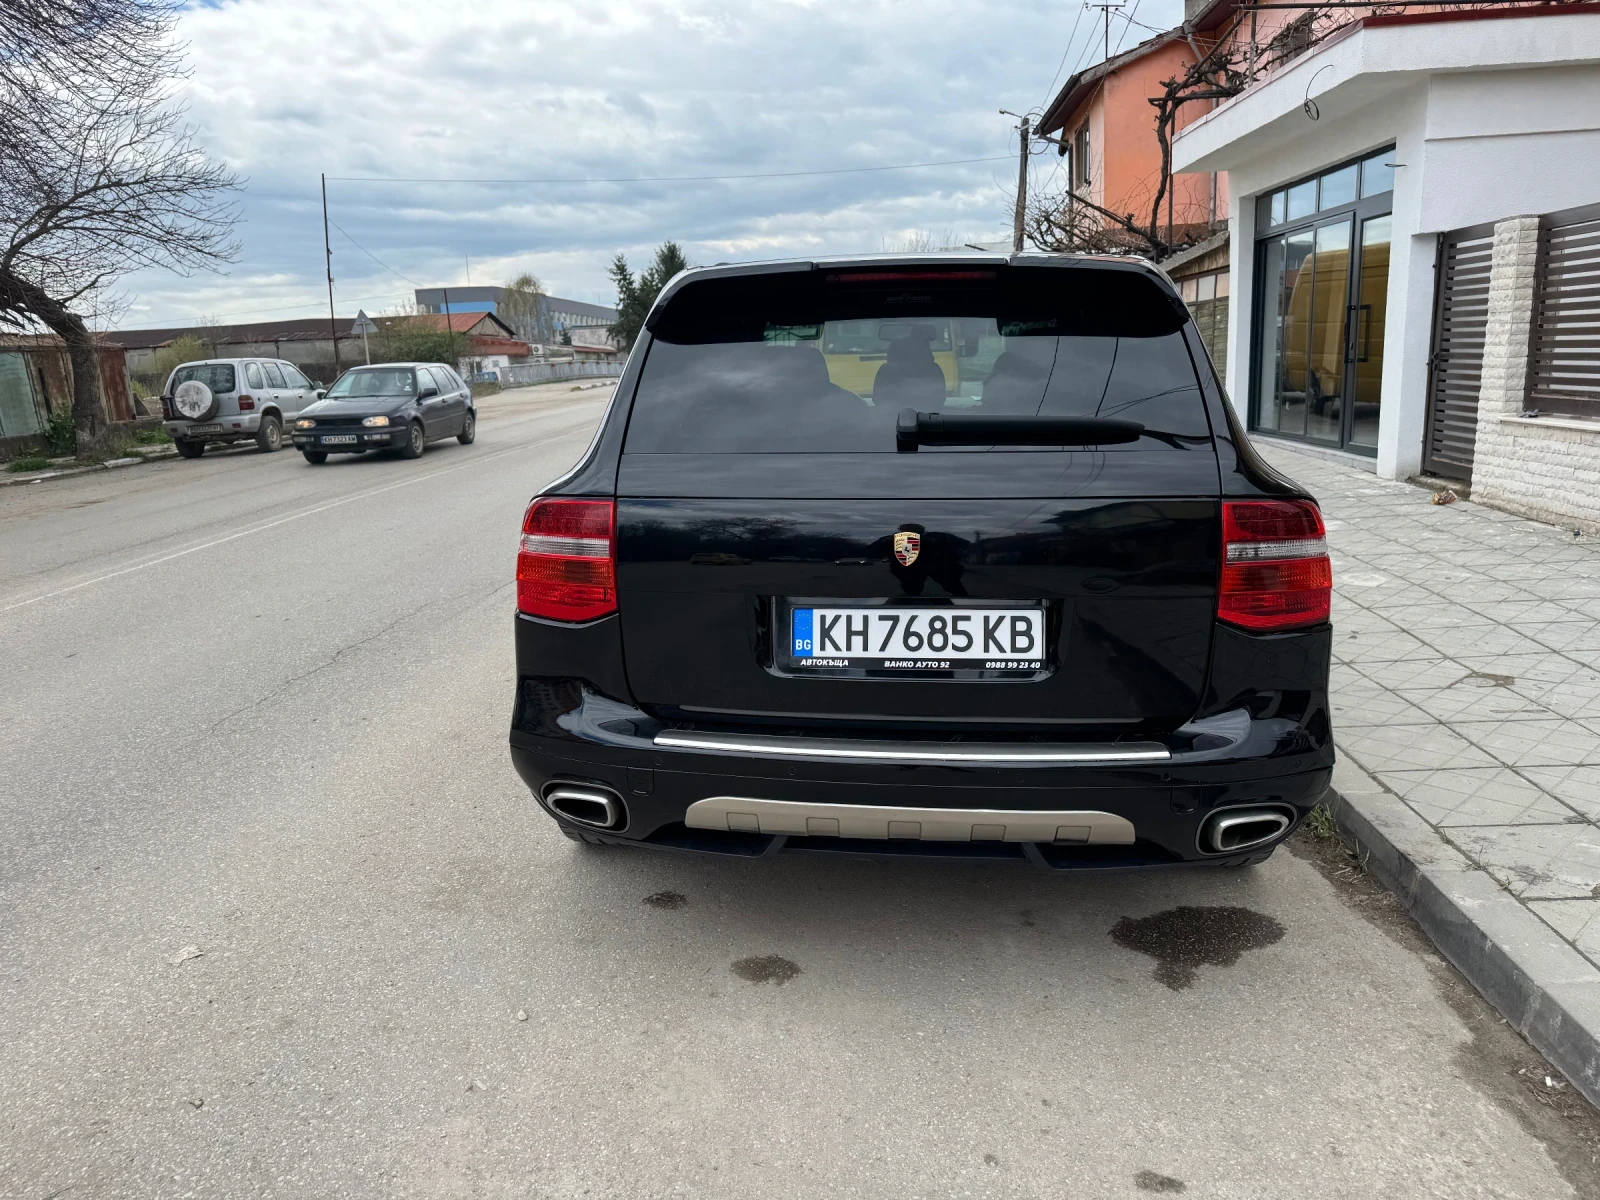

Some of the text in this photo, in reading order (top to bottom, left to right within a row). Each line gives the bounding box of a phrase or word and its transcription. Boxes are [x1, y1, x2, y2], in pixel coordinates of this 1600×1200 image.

[796, 640, 811, 651] BG
[800, 658, 849, 667] АВТОКЪЩА
[884, 660, 950, 669] ВАНКО АУТО 92
[985, 661, 1041, 669] 0988 99 23 40
